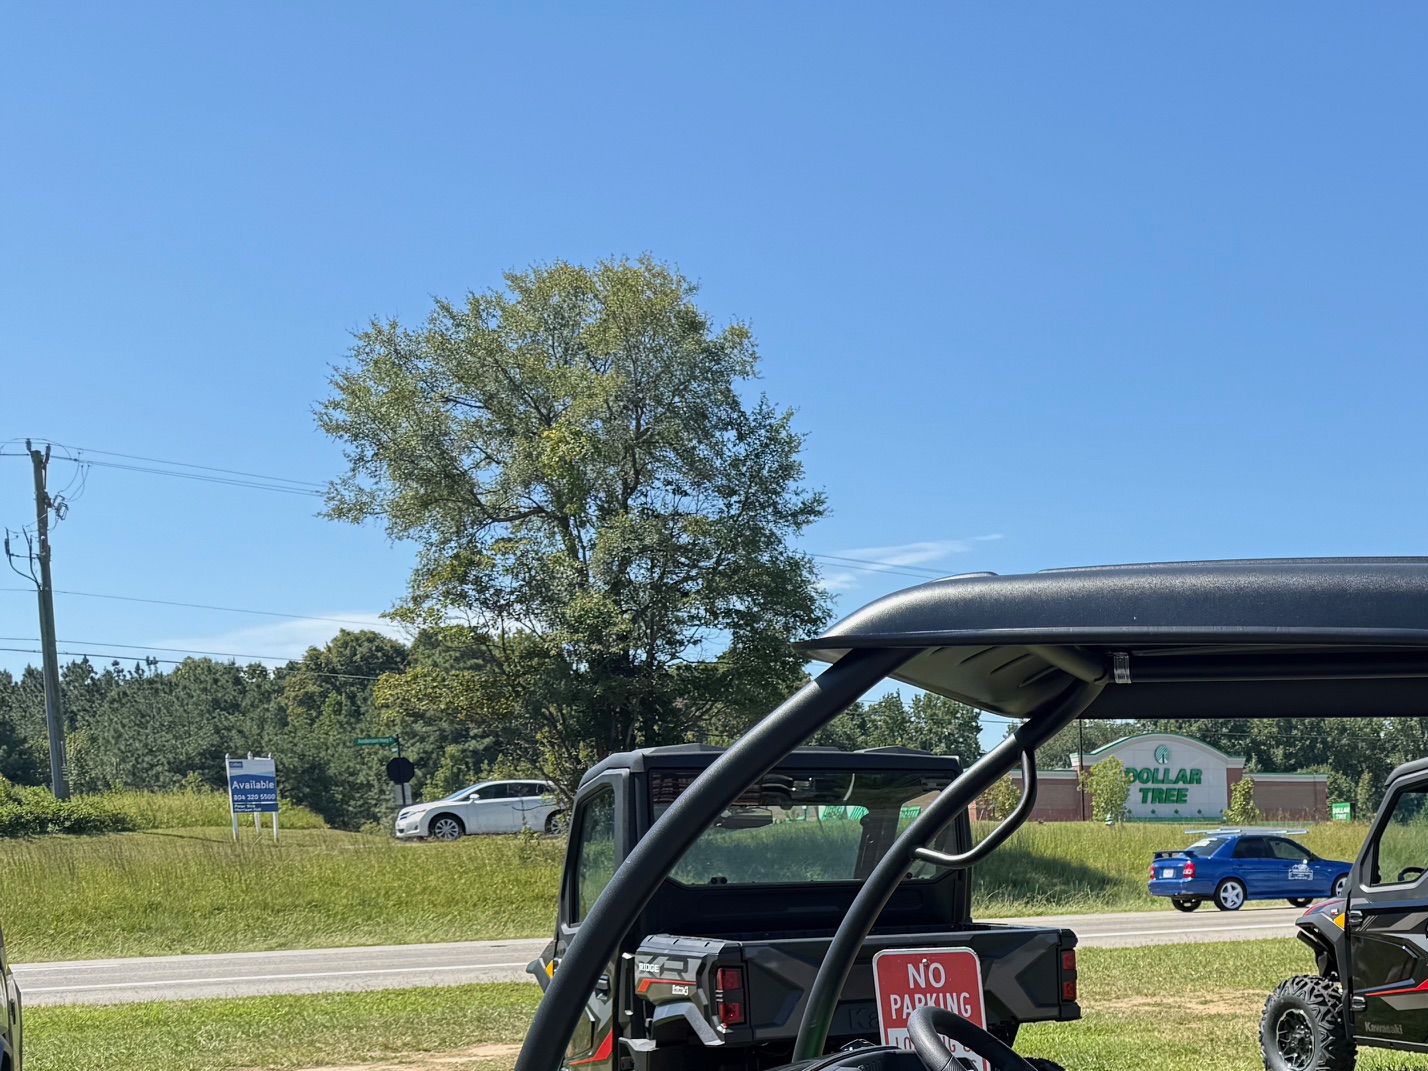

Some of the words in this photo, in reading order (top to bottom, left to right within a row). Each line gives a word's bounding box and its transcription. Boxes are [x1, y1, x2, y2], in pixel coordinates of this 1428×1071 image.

[1125, 767, 1203, 785] DOLLAR
[232, 780, 275, 789] Available
[1139, 787, 1189, 804] TREE
[639, 963, 660, 973] RIDGE
[907, 962, 946, 989] NO
[1364, 1021, 1404, 1035] Kawasaki
